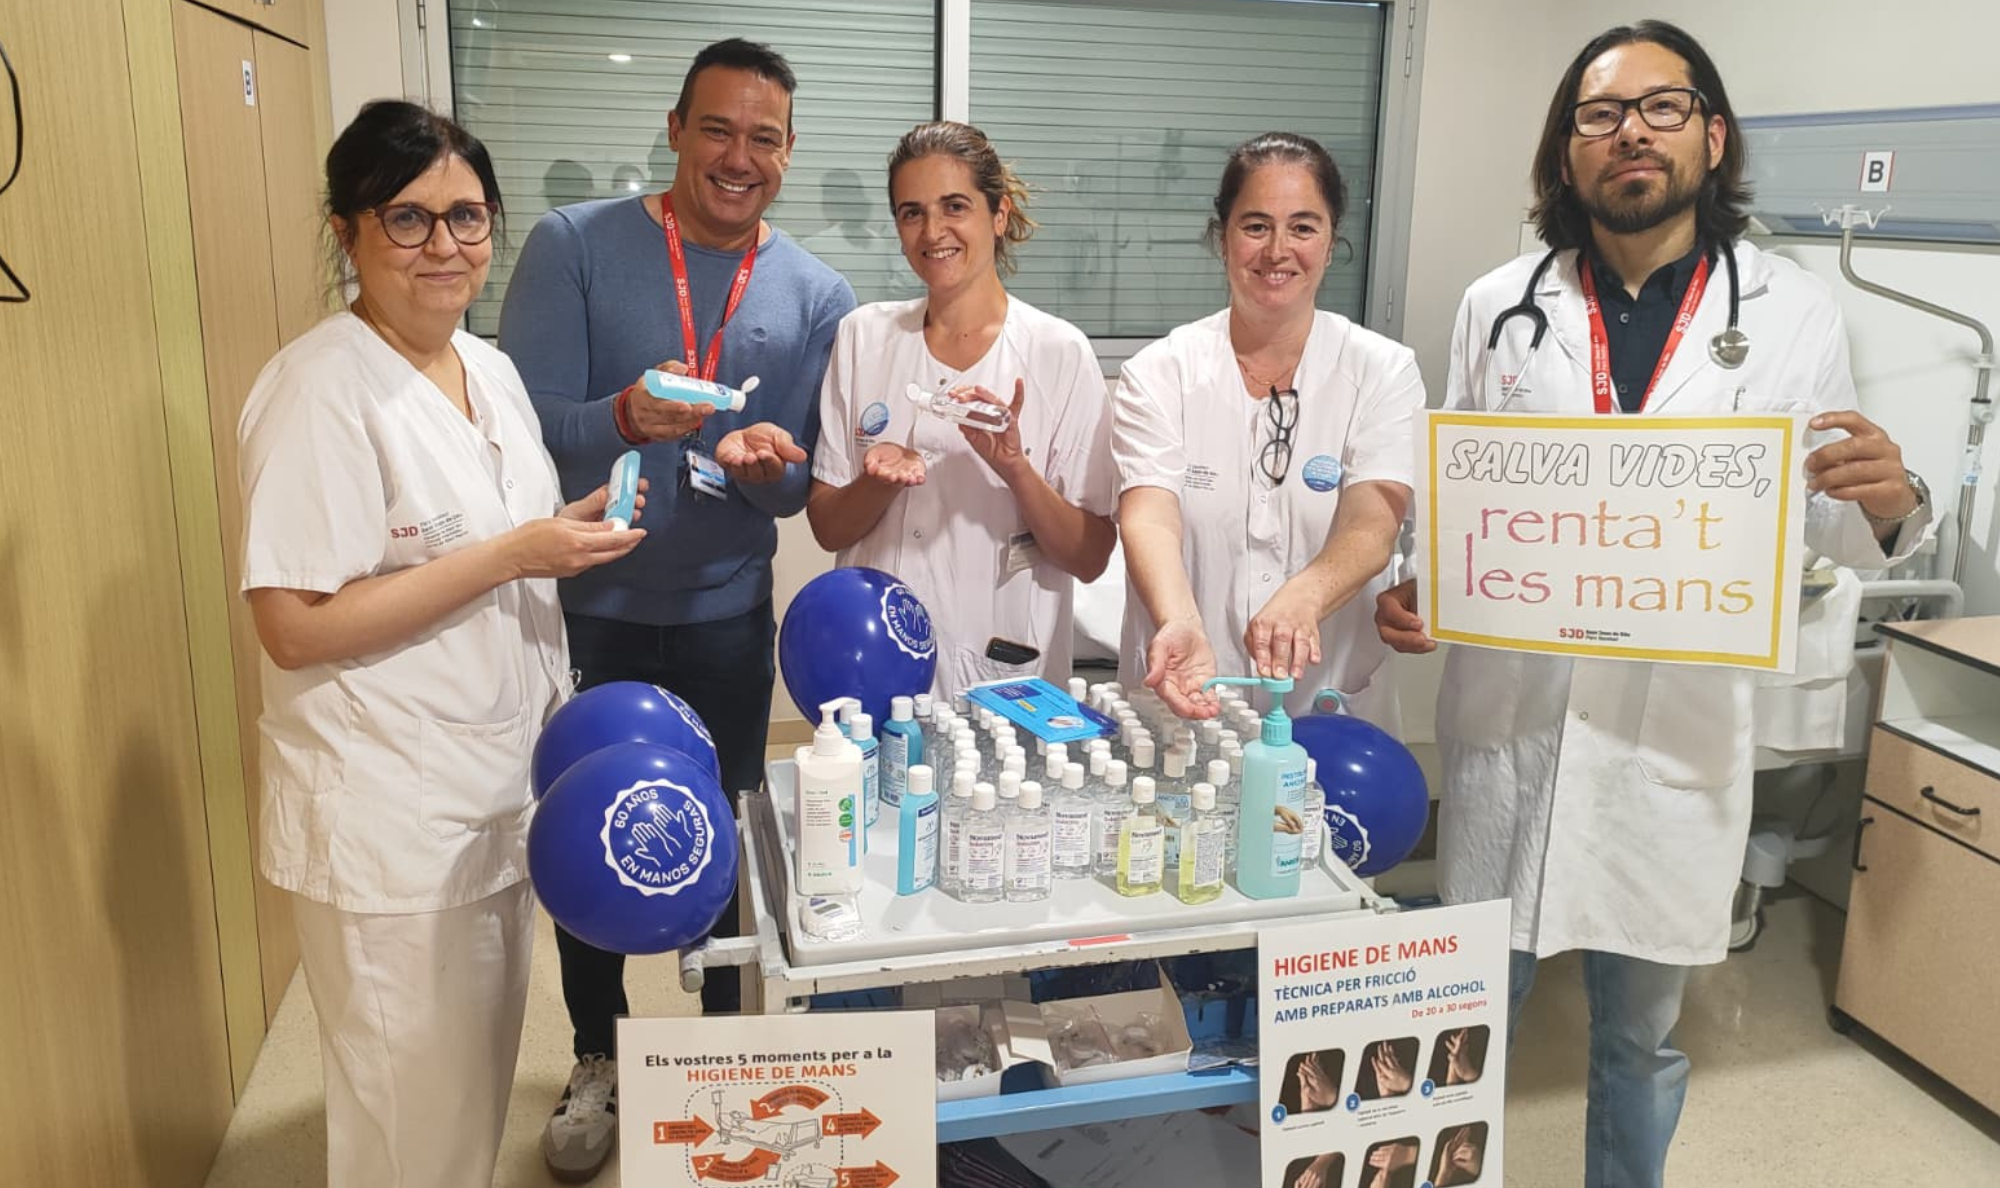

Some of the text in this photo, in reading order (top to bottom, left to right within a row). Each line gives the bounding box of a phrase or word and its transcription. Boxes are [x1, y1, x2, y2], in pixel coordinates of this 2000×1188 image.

[1868, 160, 1884, 183] B
[677, 278, 688, 297] SJD
[1596, 371, 1608, 395] SJD
[1446, 439, 1771, 498] SALVA VIDES,
[390, 526, 419, 539] SJD
[1465, 532, 1755, 614] les mans
[1559, 627, 1584, 640] SJD
[620, 800, 705, 883] EN MANOS SEGURAS
[1274, 935, 1458, 977] HIGIENE DE MANS
[1275, 967, 1416, 1002] TÈCNICA PER FRICCIÓ
[1274, 979, 1486, 1024] AMB PREPARATS AMB ALCOHOL
[1411, 1008, 1424, 1019] De
[1426, 1005, 1437, 1015] 20
[1447, 1002, 1457, 1012] 30
[1459, 998, 1488, 1012] segons
[645, 1047, 893, 1067] Els vostres 5 moments per a la
[687, 1063, 857, 1082] HIGIENE DE MANS
[759, 1102, 776, 1114] 2
[657, 1126, 666, 1140] 1
[825, 1118, 836, 1133] 4
[697, 1156, 714, 1171] 3
[840, 1172, 850, 1187] 5
